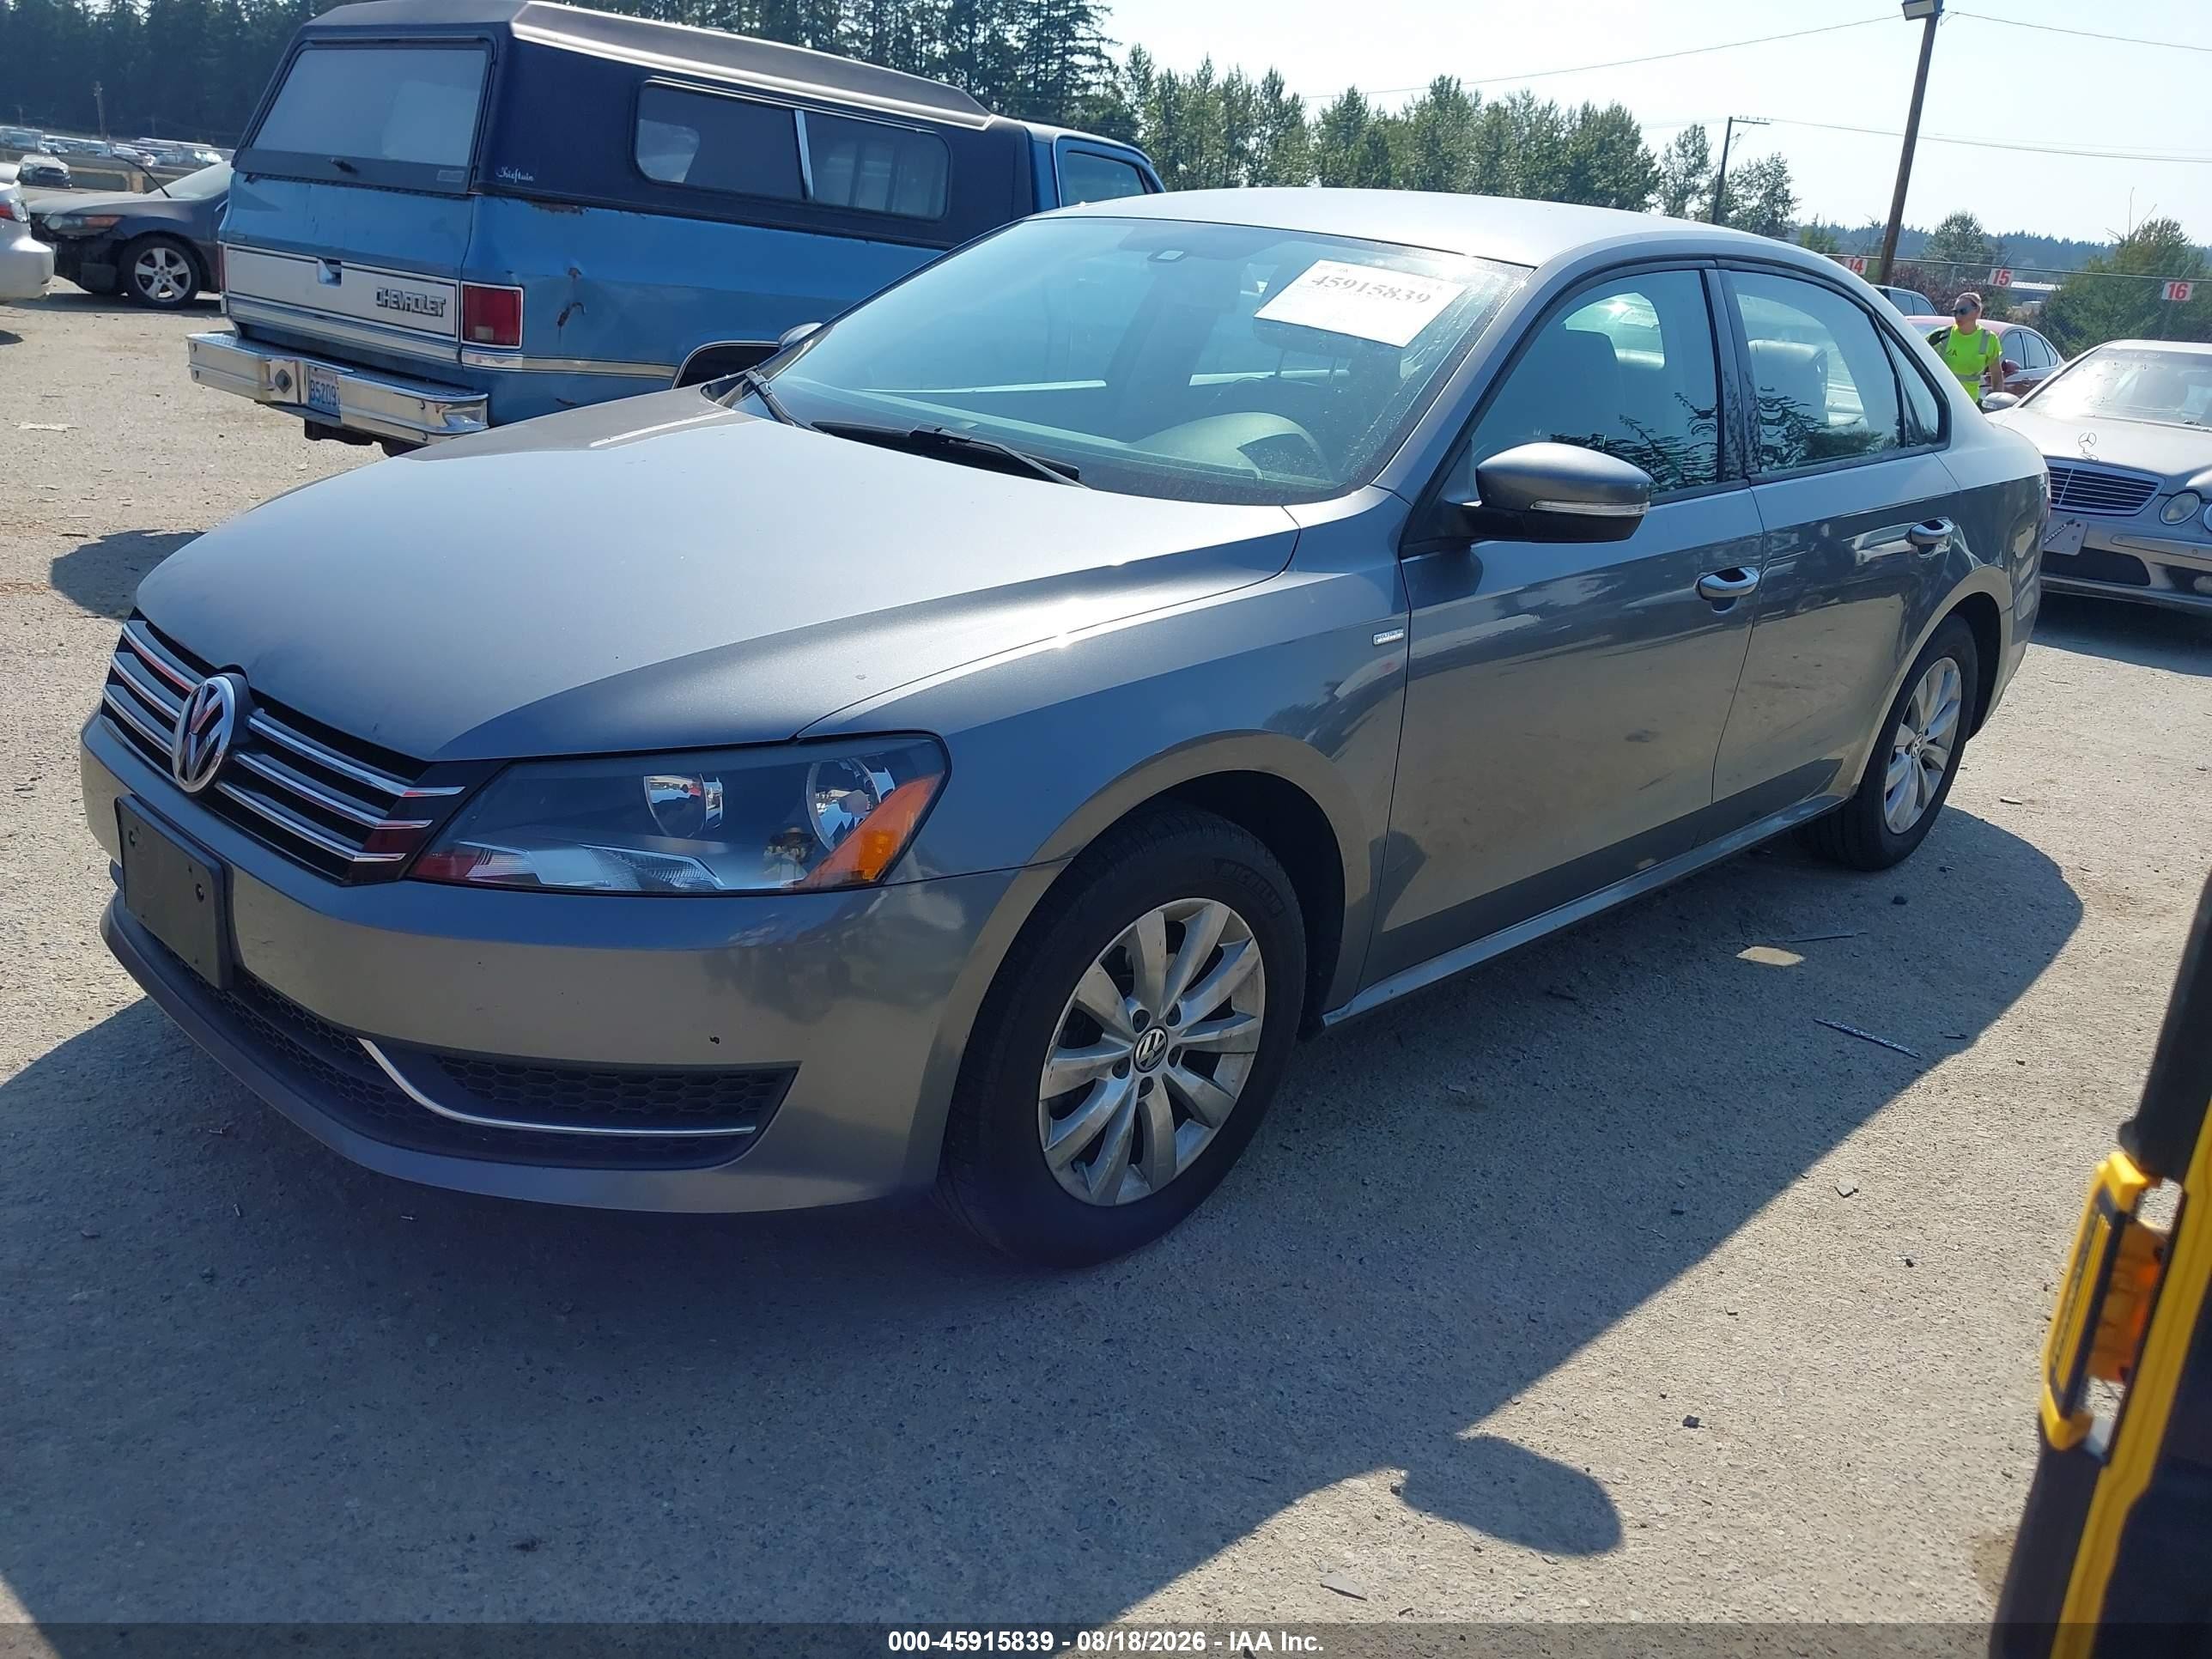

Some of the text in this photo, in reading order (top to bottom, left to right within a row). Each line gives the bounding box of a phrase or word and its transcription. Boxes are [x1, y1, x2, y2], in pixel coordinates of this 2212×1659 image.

[1848, 258, 1863, 273] 14
[1993, 269, 2011, 286] 15
[1311, 275, 1431, 304] 45915839
[2168, 283, 2189, 300] 16
[375, 287, 447, 318] CHEVROLET
